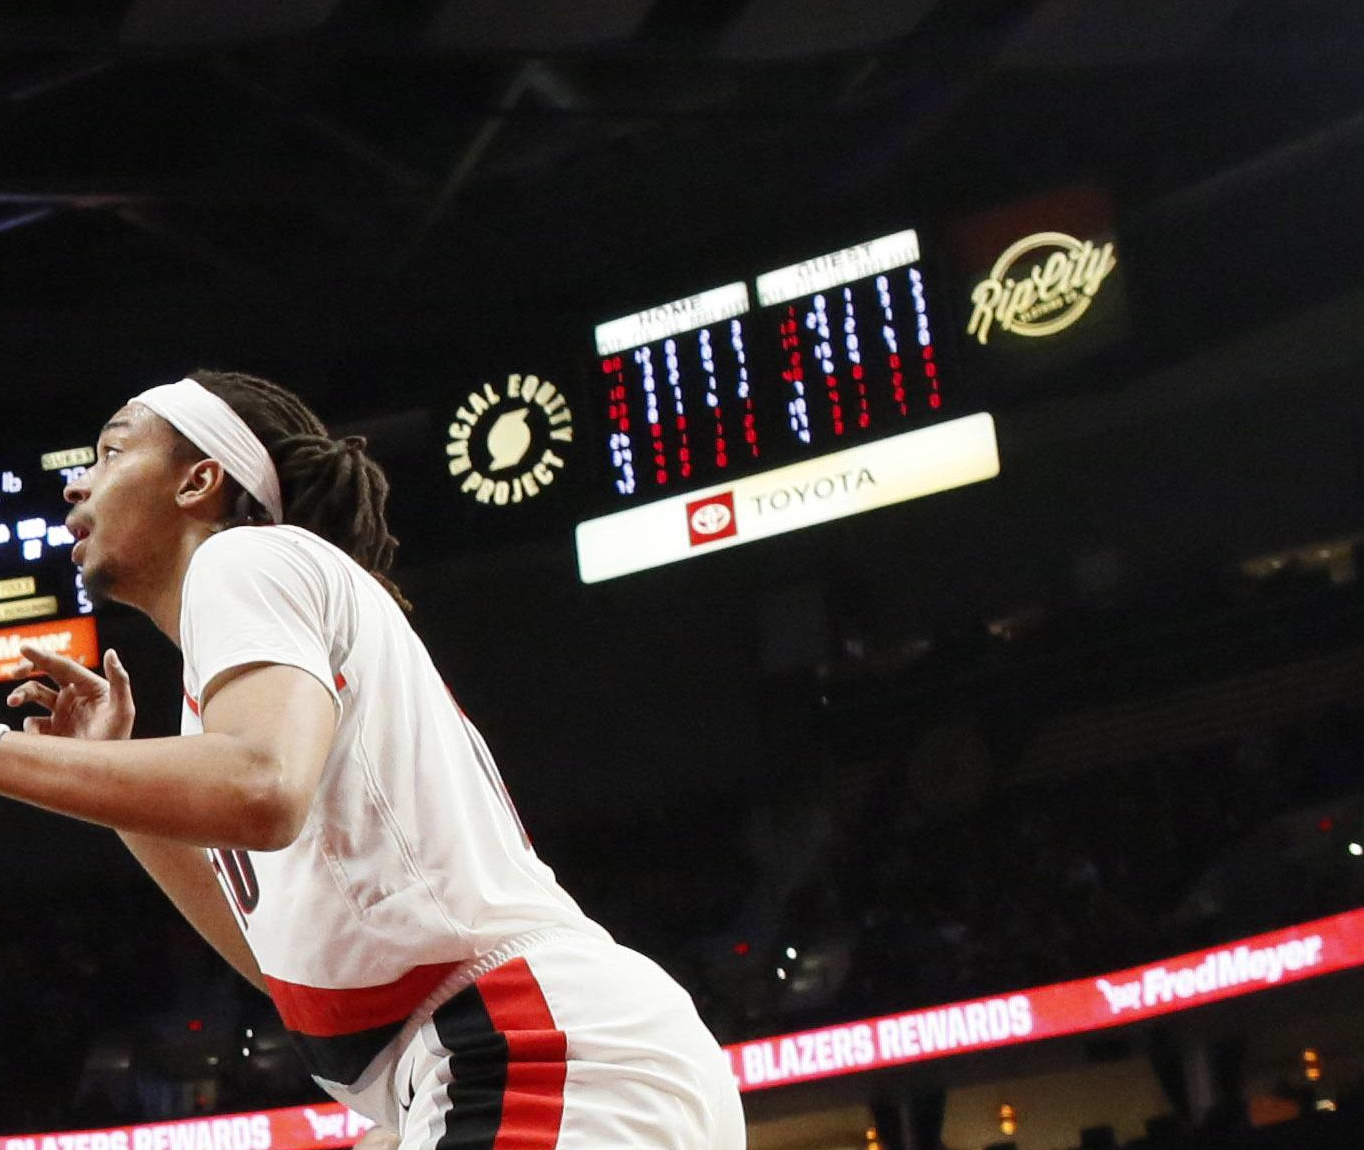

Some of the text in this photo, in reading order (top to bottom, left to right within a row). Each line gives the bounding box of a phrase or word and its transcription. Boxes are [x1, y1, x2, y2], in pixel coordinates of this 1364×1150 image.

[446, 383, 500, 476] RACIAL
[507, 373, 572, 442] EQUITY
[461, 449, 564, 506] PROJECT
[751, 468, 878, 515] TOYOTA
[743, 1024, 874, 1084] BLAZERS
[878, 995, 1033, 1061] REWARDS
